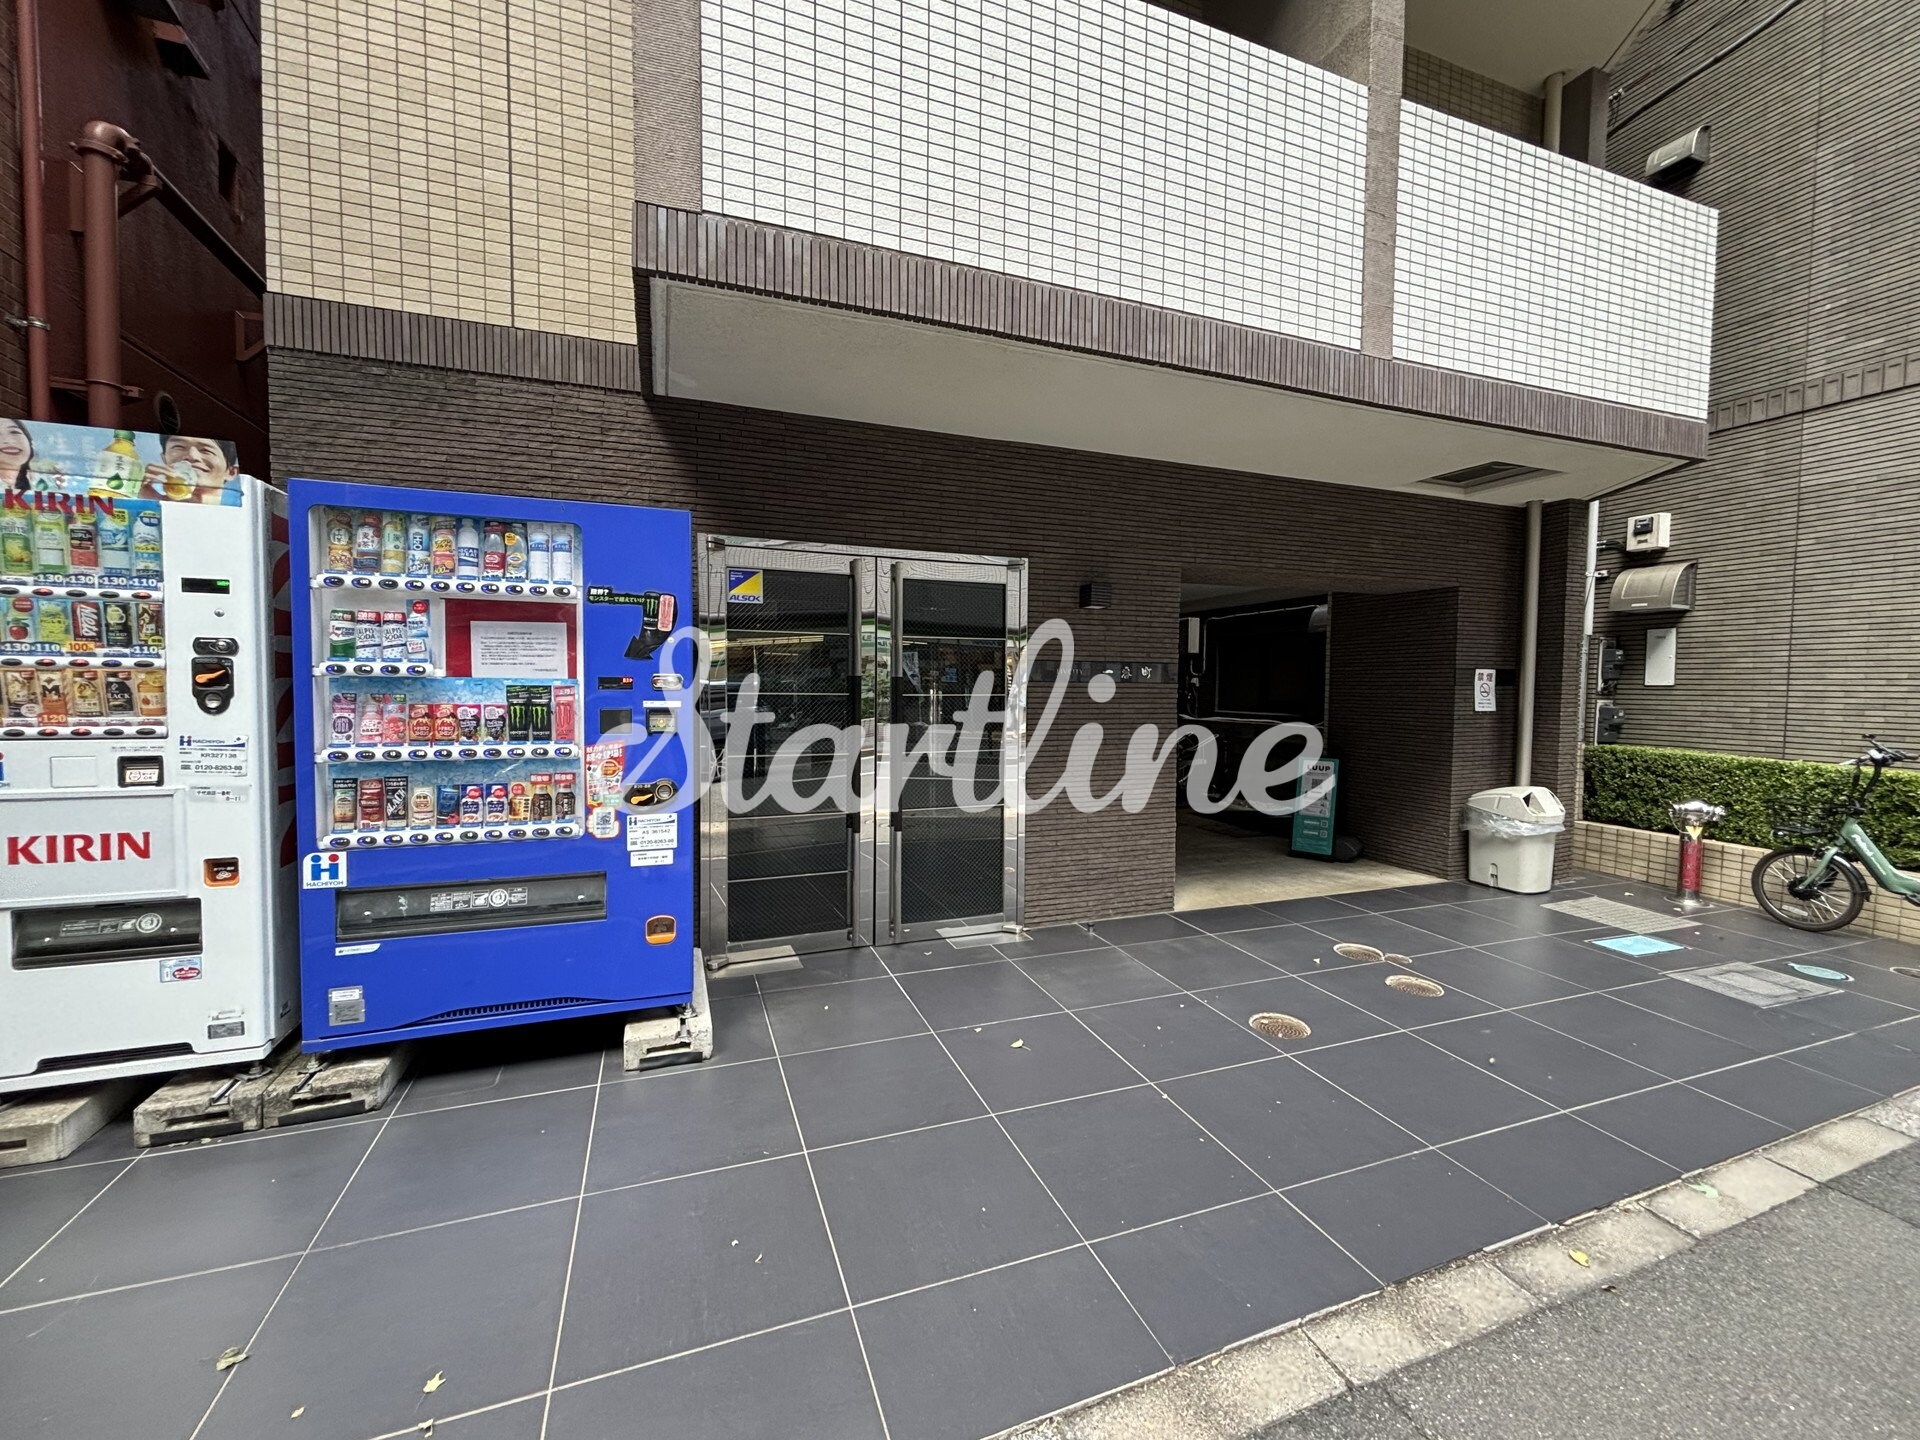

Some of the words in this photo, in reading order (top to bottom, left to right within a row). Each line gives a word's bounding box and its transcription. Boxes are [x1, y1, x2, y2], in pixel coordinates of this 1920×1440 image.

[4, 488, 115, 516] KIRIN
[43, 714, 66, 723] 120
[386, 788, 407, 817] BLACK
[6, 831, 151, 866] KIRIN
[306, 880, 344, 888] HACHIYOH
